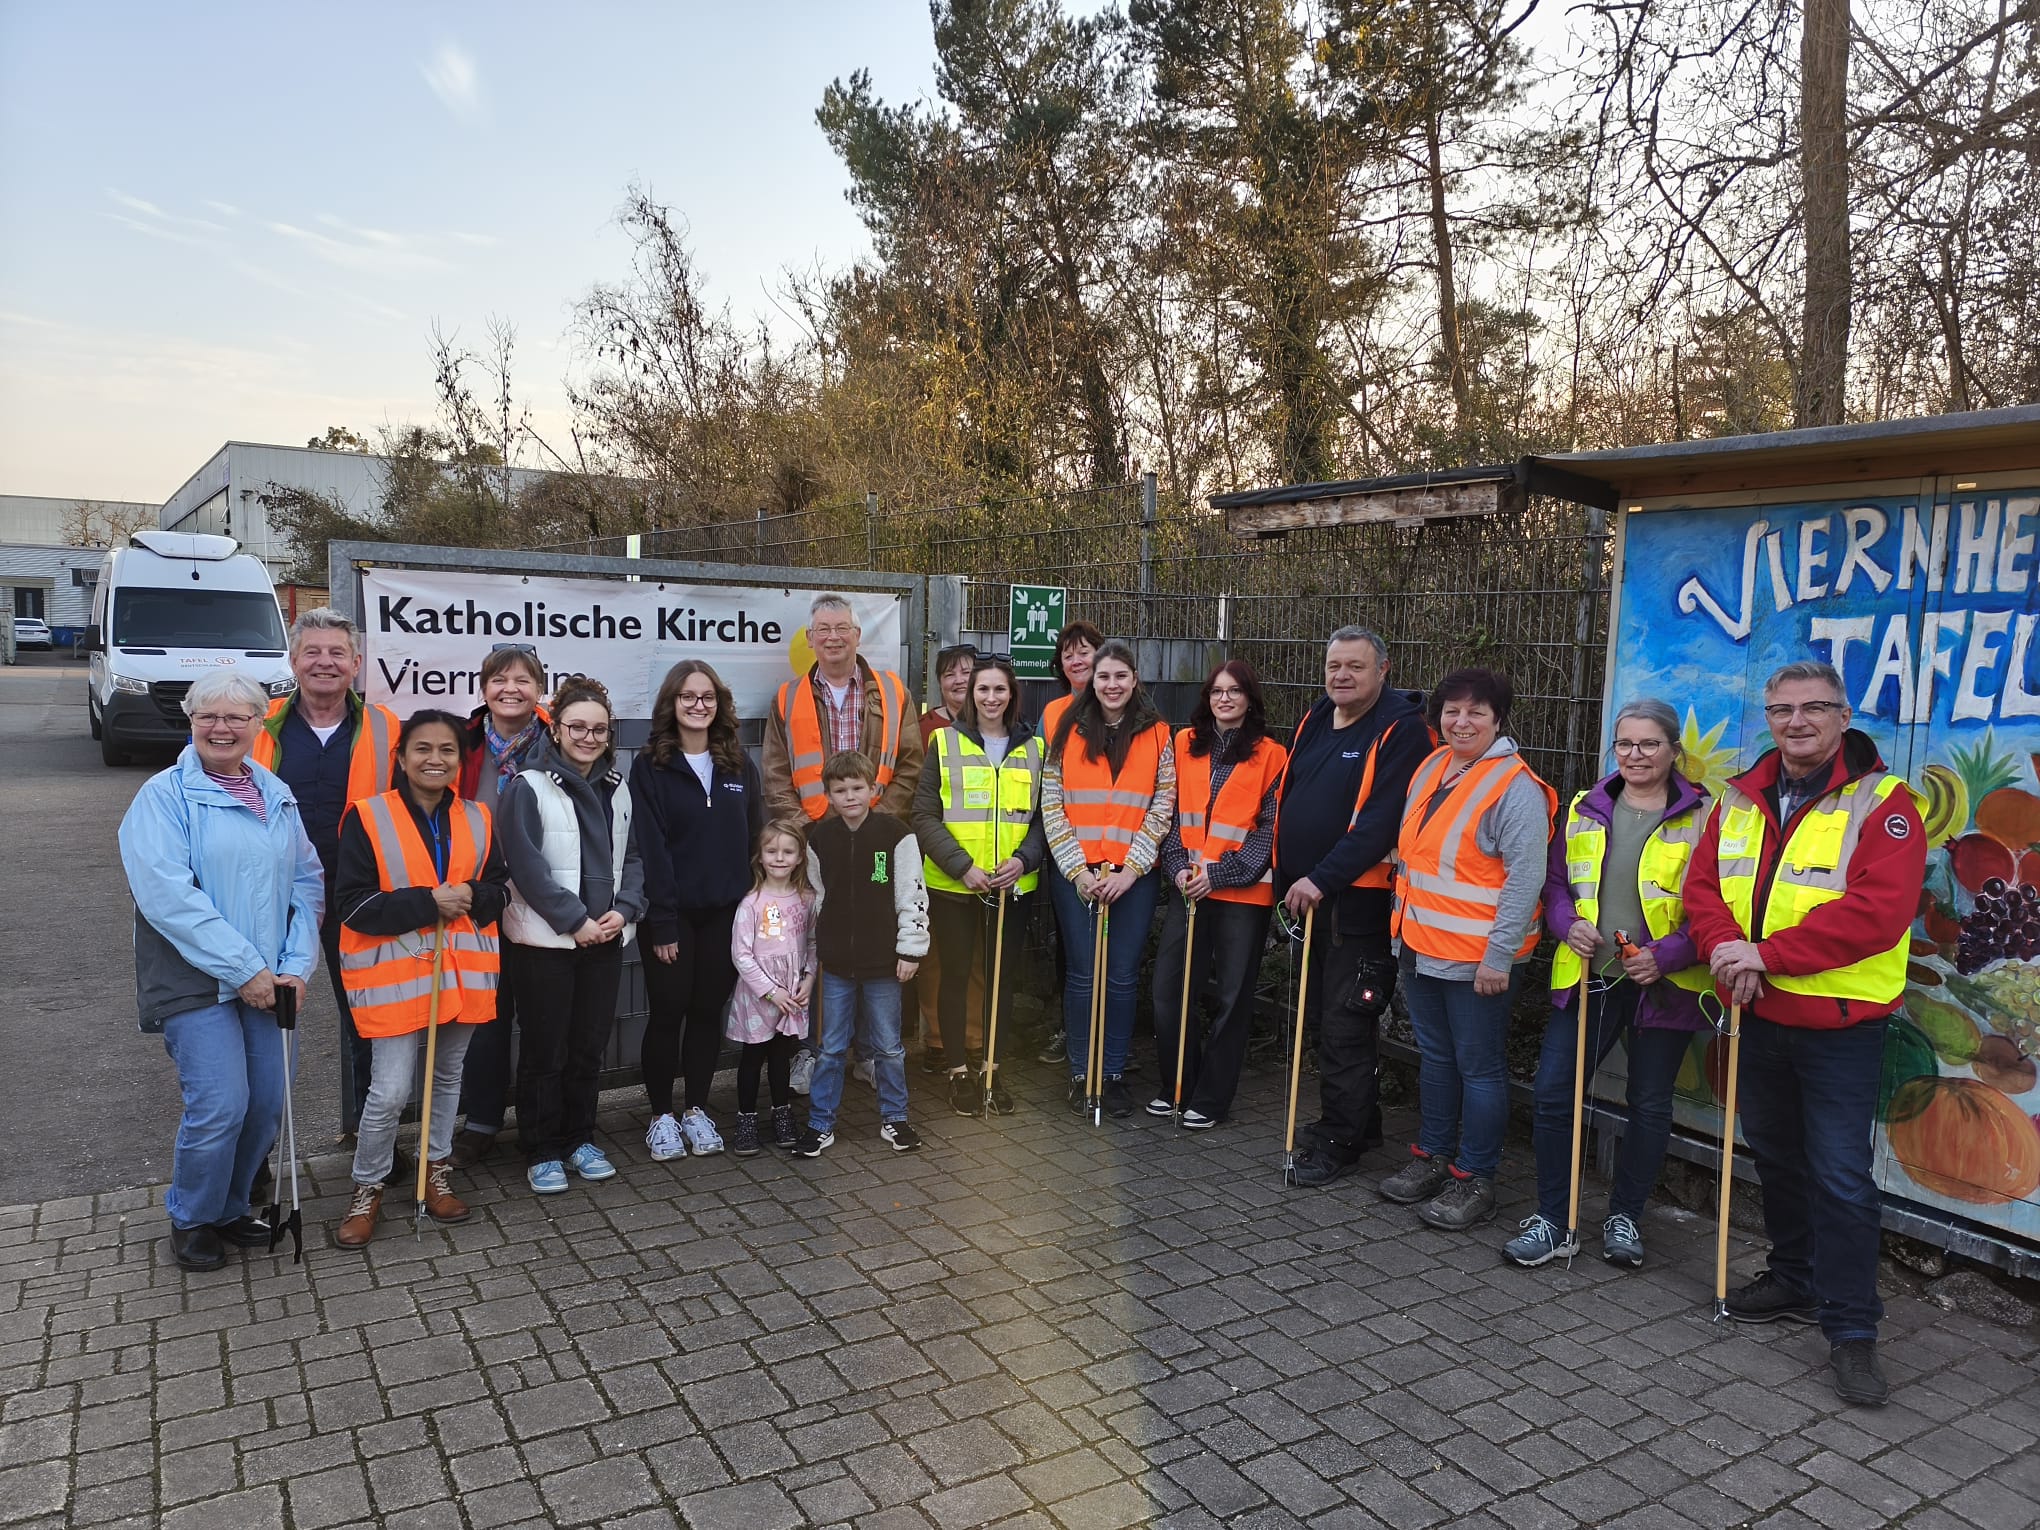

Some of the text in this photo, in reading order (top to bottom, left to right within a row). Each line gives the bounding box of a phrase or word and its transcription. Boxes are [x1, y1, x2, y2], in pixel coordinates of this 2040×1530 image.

[1678, 497, 2040, 641] VIERNHE
[378, 595, 782, 644] Katholische Kirche
[1810, 609, 2040, 725] TAFEL
[792, 912, 804, 925] DO
